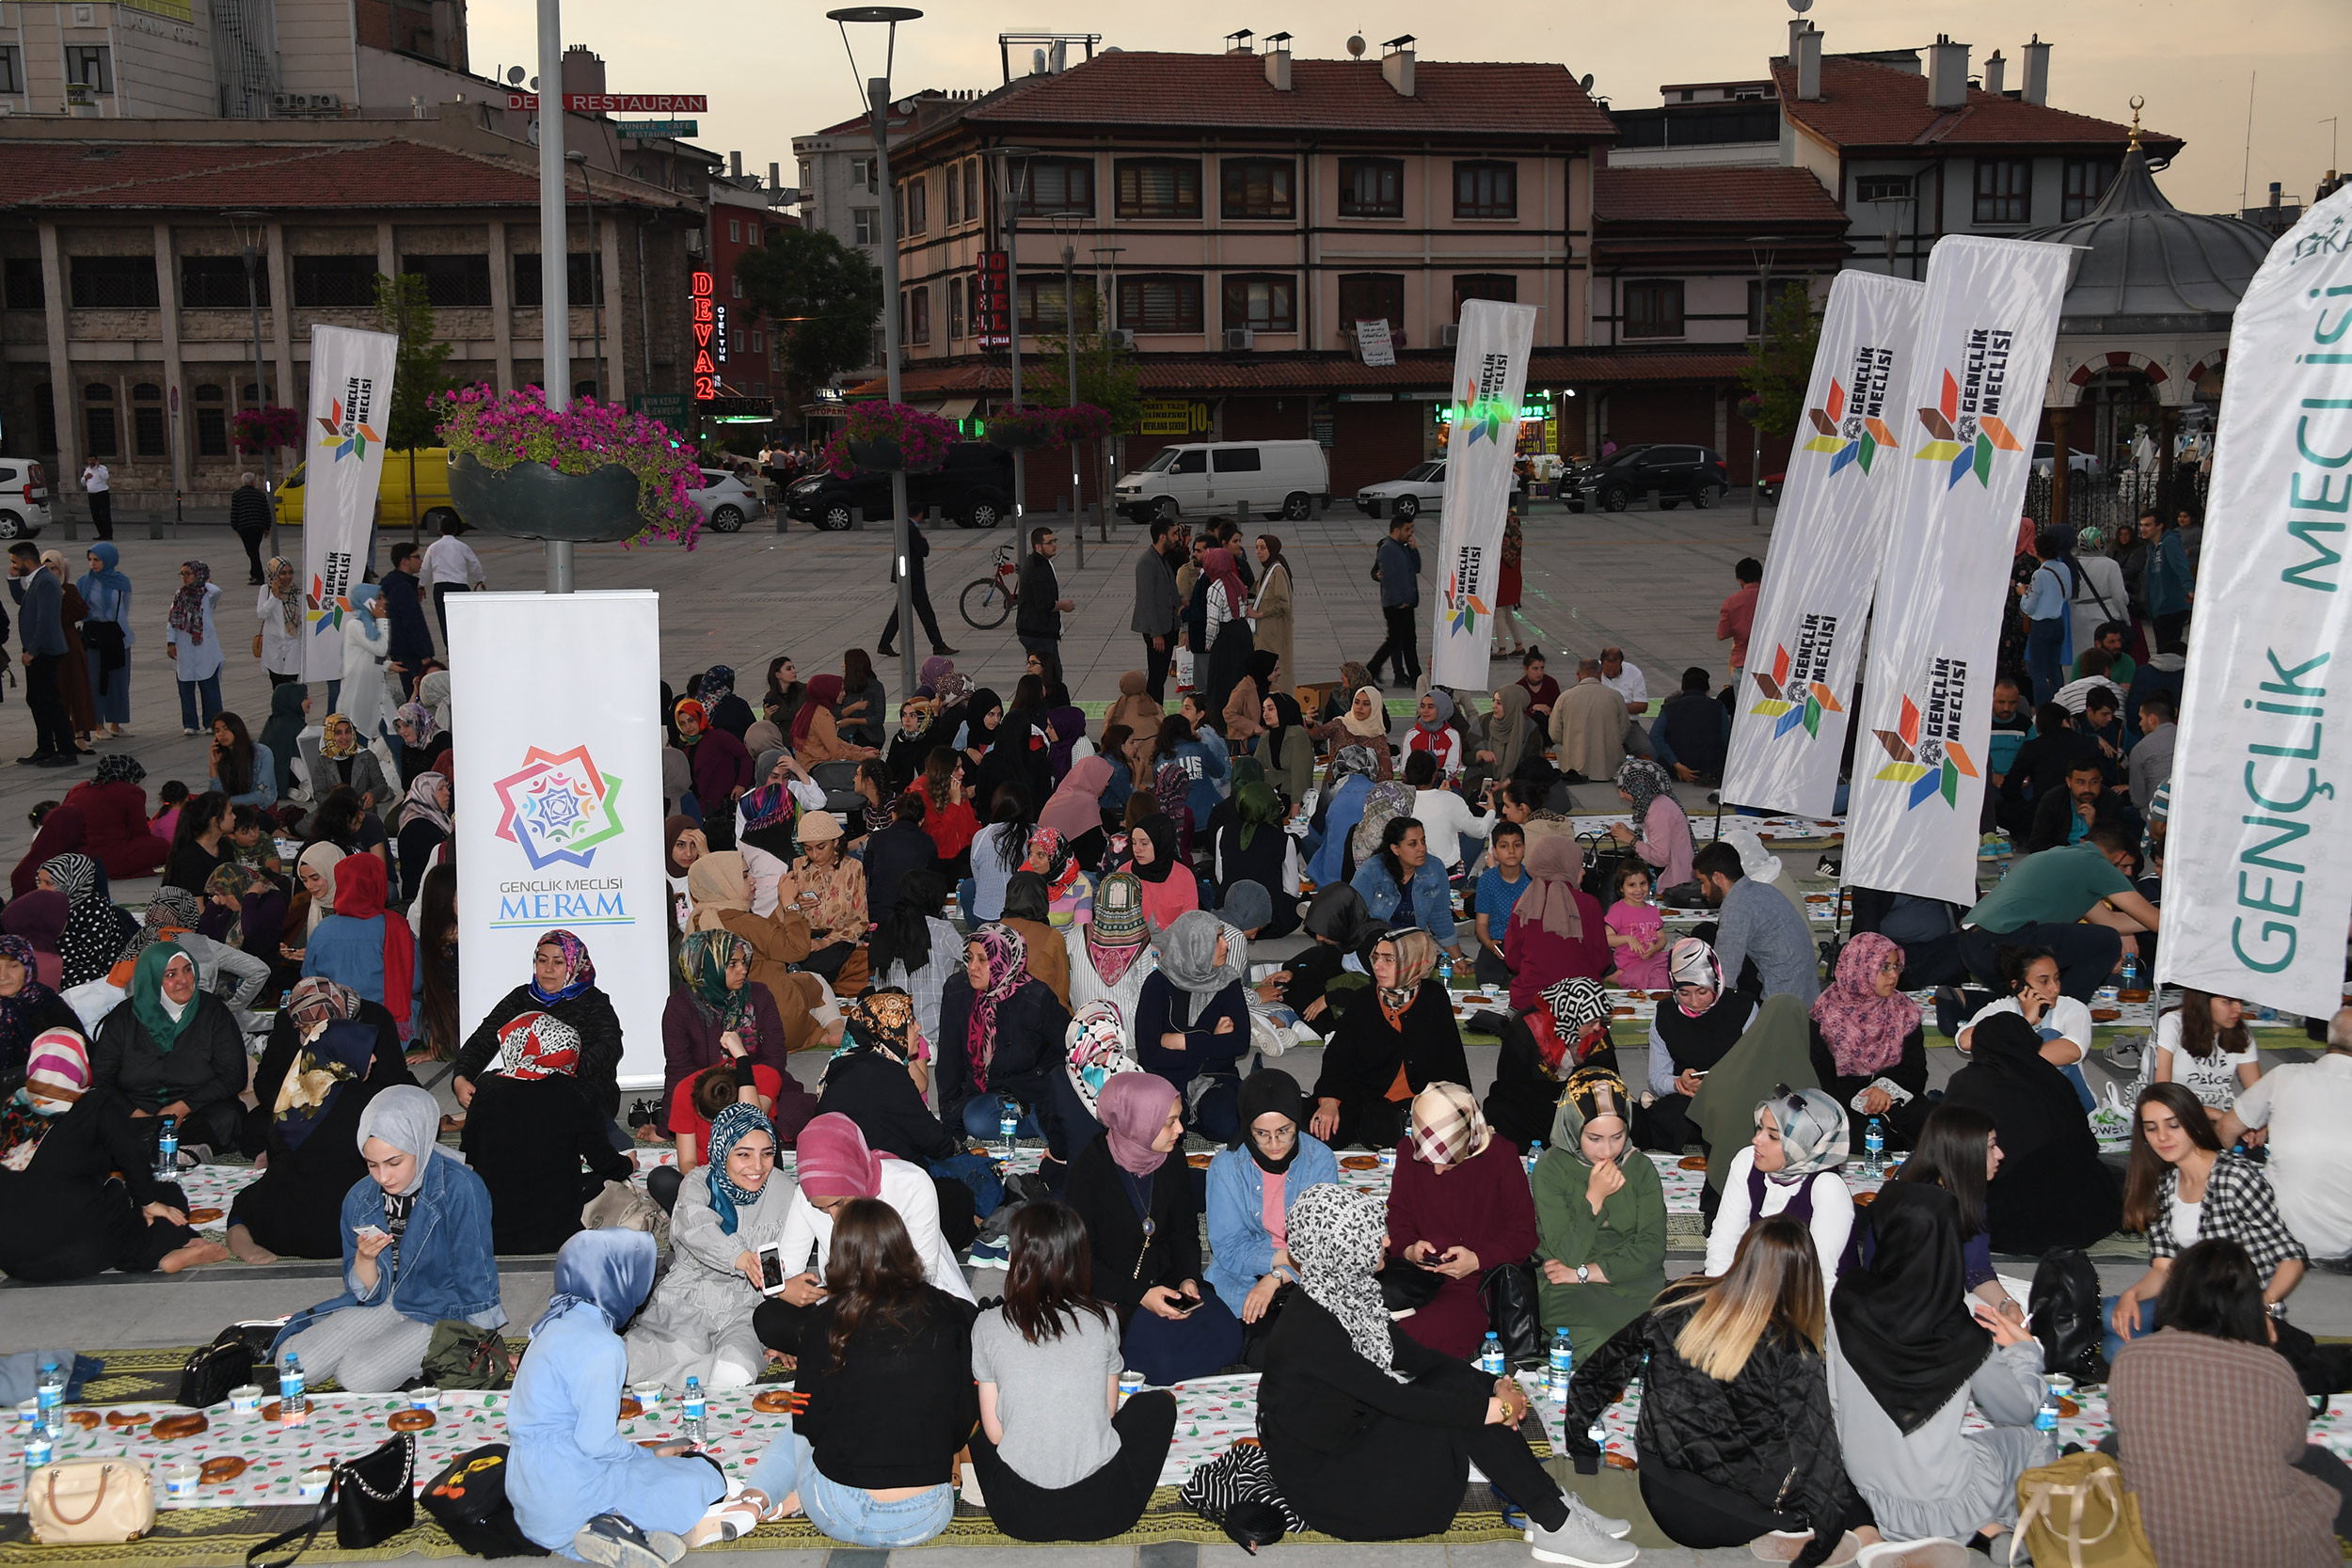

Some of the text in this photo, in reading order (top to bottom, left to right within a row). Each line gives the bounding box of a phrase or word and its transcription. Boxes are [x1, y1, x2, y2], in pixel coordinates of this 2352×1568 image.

[573, 95, 706, 111] RESTAURAN
[990, 254, 1008, 331] OTEL
[717, 307, 725, 336] OTEL
[817, 388, 836, 398] OTEL
[1479, 354, 1496, 402] GENÇLİK
[1492, 354, 1508, 403] MECLİSİ
[1850, 347, 1874, 415] GENÇLİK
[1867, 349, 1893, 418] MECLİSİ
[1963, 329, 1988, 412] GENÇLİK
[1982, 330, 2012, 416] MECLİSİ
[345, 377, 359, 421] GENÇLİK
[358, 379, 372, 423] MECLİSİ
[1189, 403, 1207, 432] 10
[1534, 406, 1544, 416] TL
[325, 552, 339, 595] GENÇLİK
[337, 553, 351, 596] MECLİSİ
[1457, 546, 1469, 594] GENÇLİK
[1468, 546, 1481, 594] MECLİSİ
[1794, 613, 1820, 679] GENÇLİK
[1812, 616, 1836, 683] MECLİSİ
[1927, 657, 1949, 737] GENÇLİK
[1947, 660, 1966, 741] MECLİSİ
[2232, 646, 2334, 974] GENÇLİK
[498, 892, 627, 920] MERAM
[500, 877, 623, 894] GENÇLİK MECLİSİ
